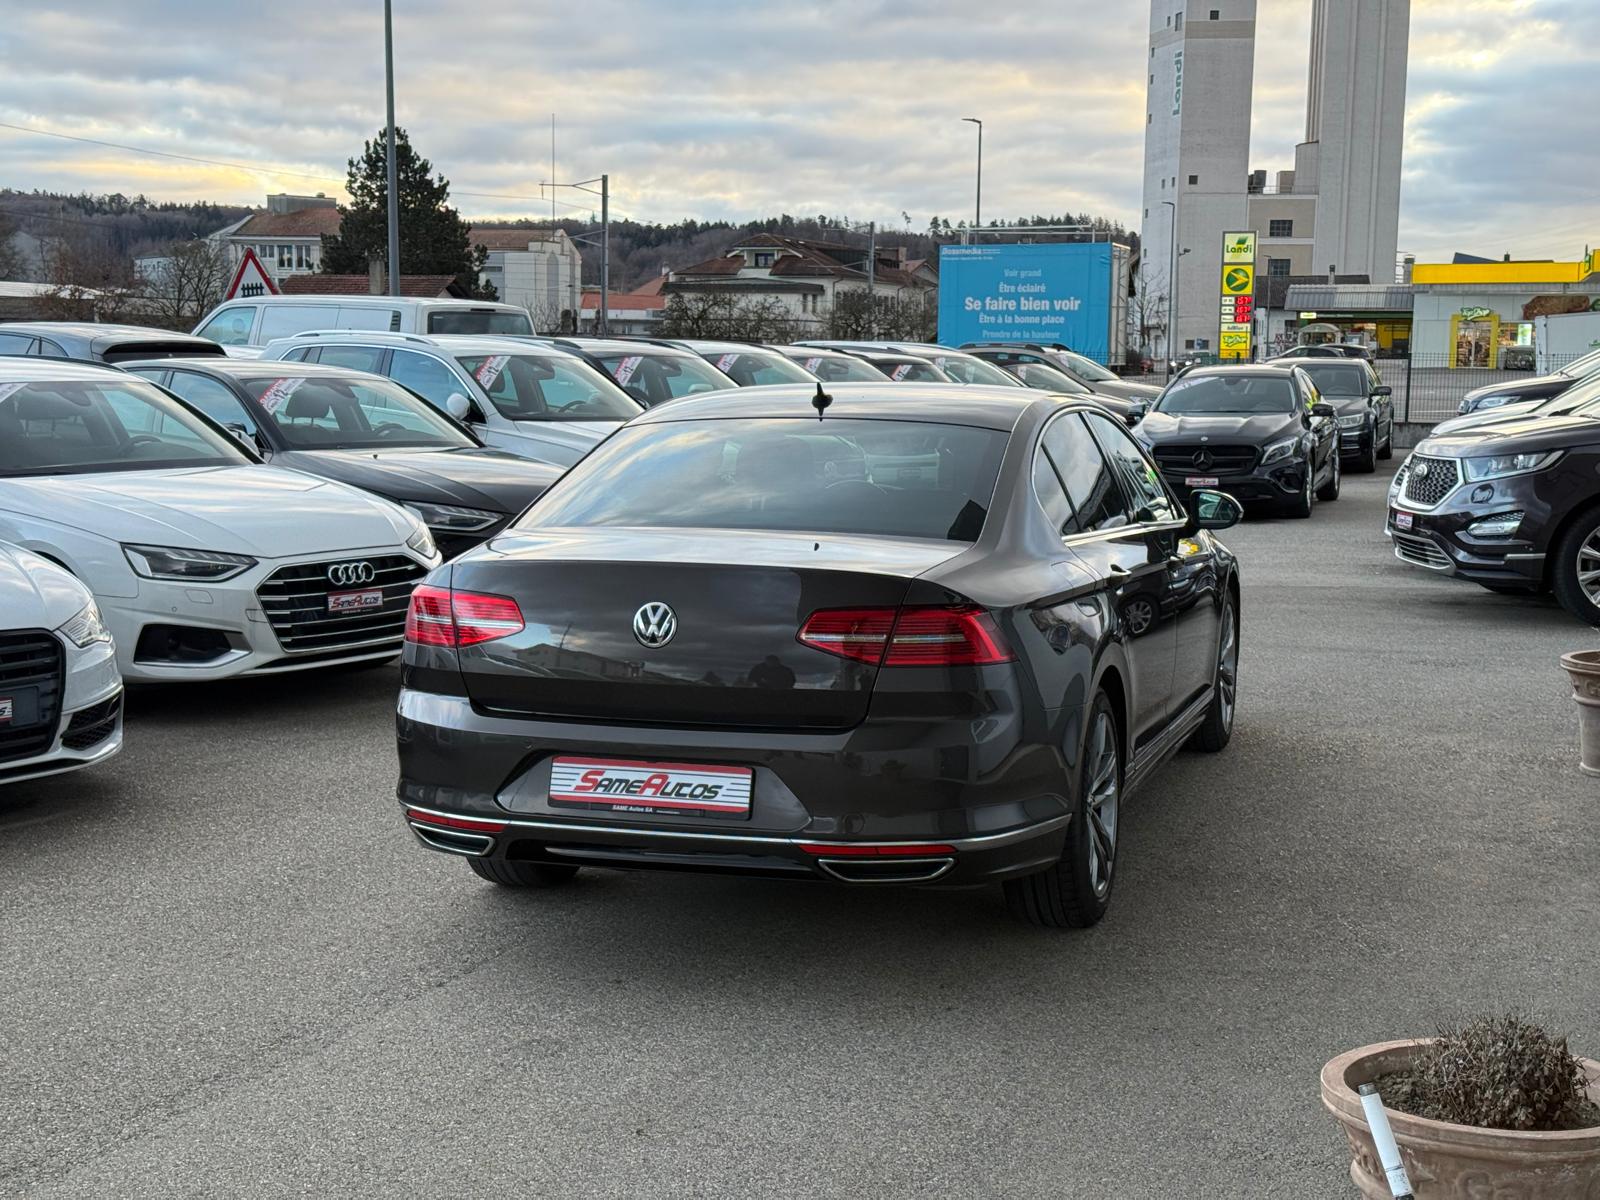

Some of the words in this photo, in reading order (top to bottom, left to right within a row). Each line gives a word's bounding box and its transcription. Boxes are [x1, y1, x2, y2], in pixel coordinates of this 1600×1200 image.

[1173, 51, 1183, 116] Landi
[1226, 244, 1252, 254] Landi
[1004, 269, 1018, 277] Voir
[1020, 268, 1042, 279] grand
[999, 282, 1015, 293] Être
[1017, 284, 1046, 293] éclairé
[965, 296, 982, 311] Se
[985, 296, 1016, 311] faire
[1020, 296, 1049, 311] bien
[1054, 296, 1080, 311] voir
[979, 312, 995, 324] Être
[997, 314, 1002, 324] à
[1005, 315, 1012, 324] la
[1015, 315, 1039, 324] bonne
[1042, 315, 1065, 325] place
[1012, 330, 1021, 339] de
